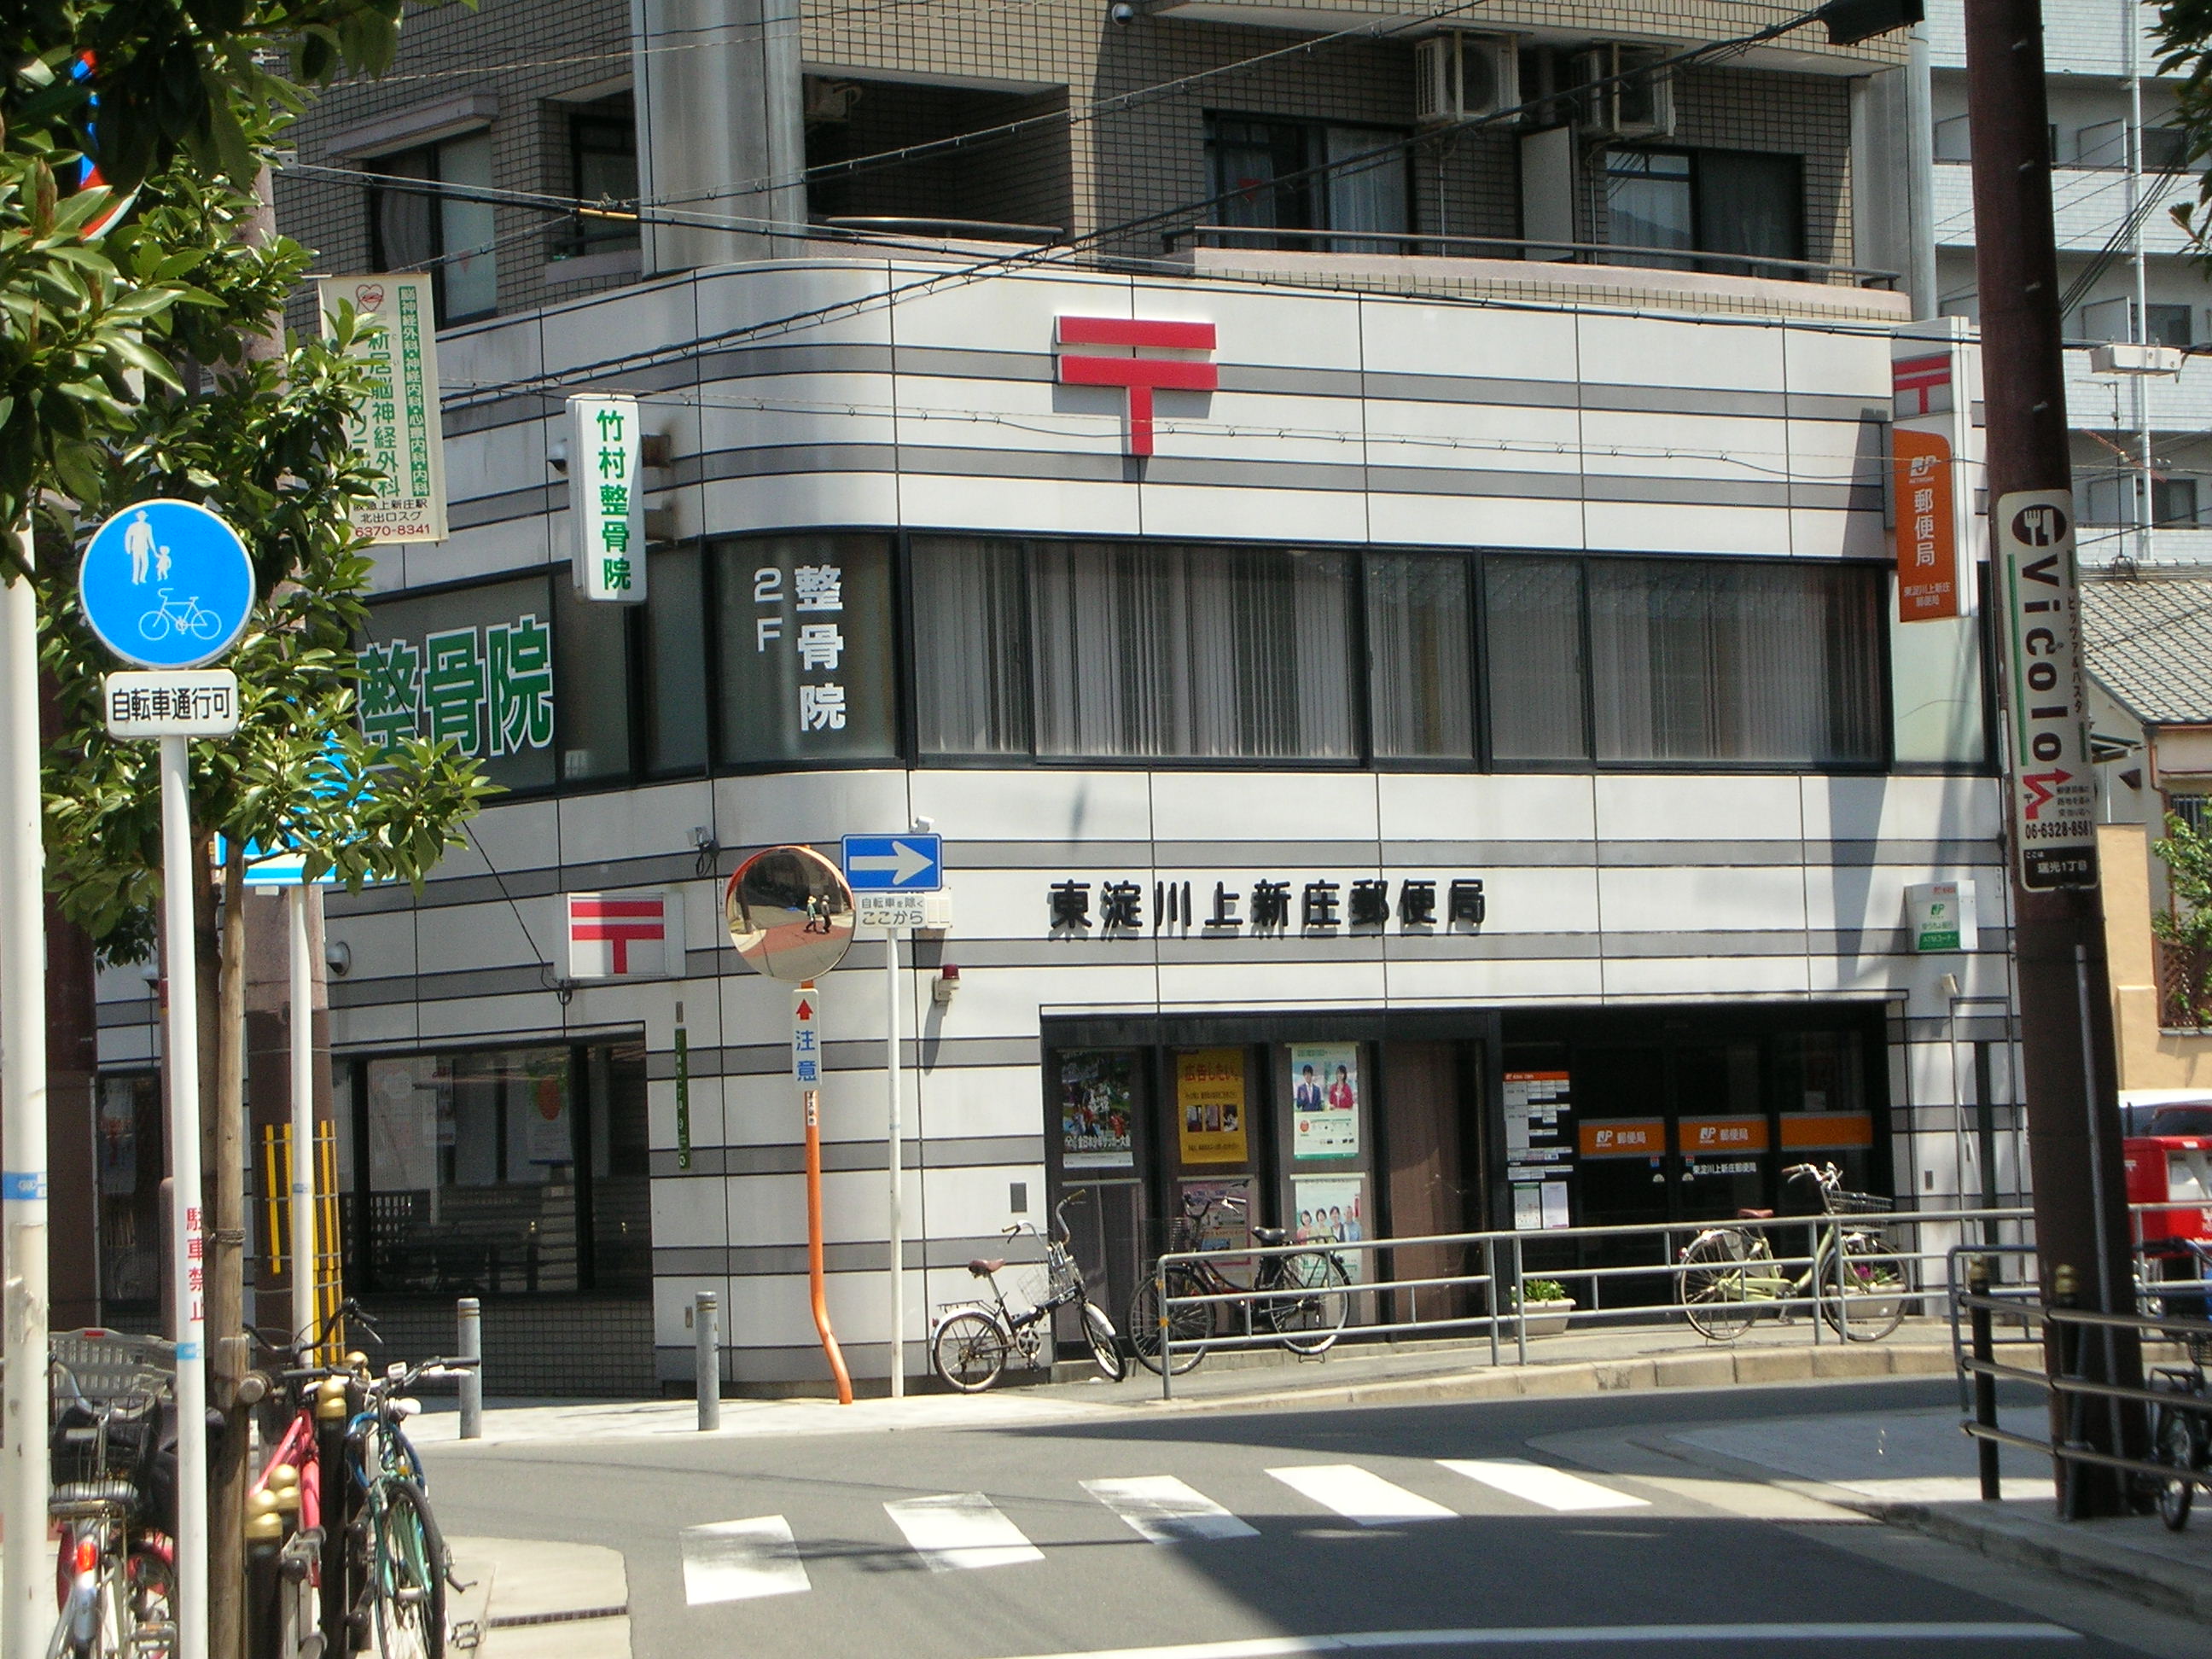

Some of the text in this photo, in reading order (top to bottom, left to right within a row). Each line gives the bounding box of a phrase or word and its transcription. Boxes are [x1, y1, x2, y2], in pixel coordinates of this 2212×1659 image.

[597, 409, 632, 591] 竹村整骨院
[355, 523, 430, 538] 6370-8341
[1913, 488, 1936, 568] 郵便局
[794, 564, 847, 732] 整骨院
[112, 686, 231, 721] 自転車通行可
[356, 613, 554, 771] 整骨院
[861, 897, 923, 908] 自転車を除く
[862, 910, 923, 925] ここから
[1050, 877, 1487, 928] 東淀川上新庄郵便局
[795, 1029, 817, 1082] 注意
